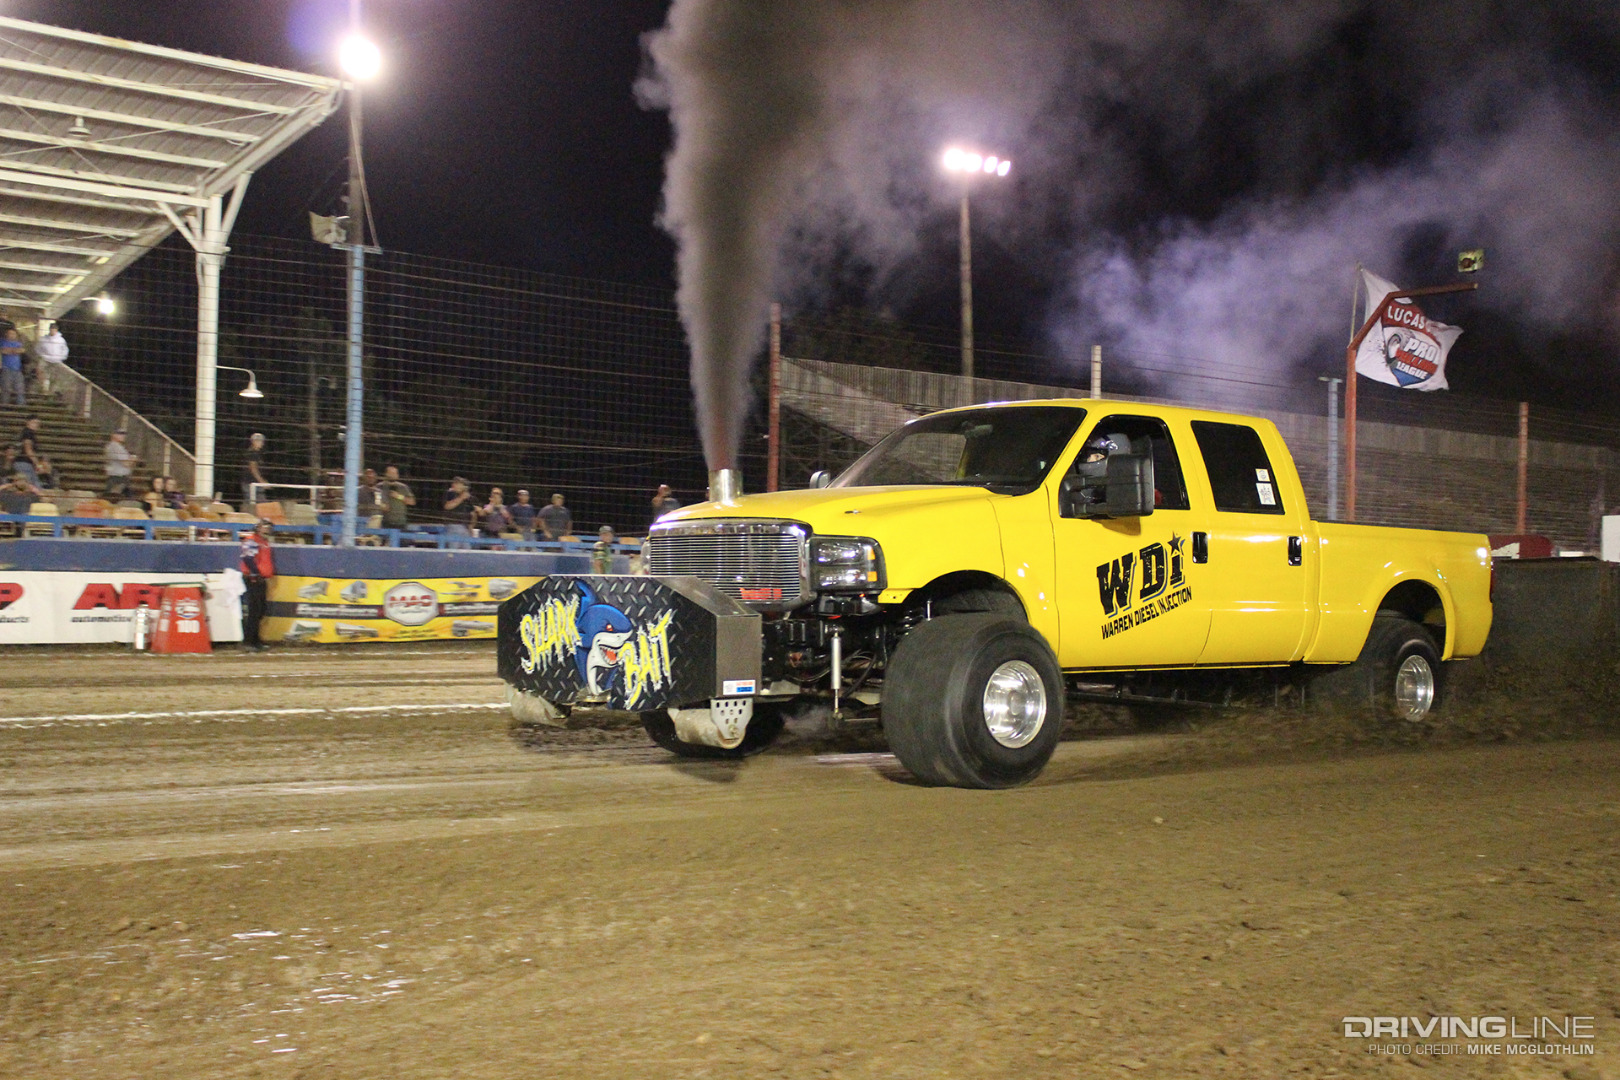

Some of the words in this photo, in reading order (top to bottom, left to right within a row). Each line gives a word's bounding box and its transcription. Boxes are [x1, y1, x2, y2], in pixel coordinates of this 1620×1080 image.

[1387, 305, 1427, 330] LUCAS
[1403, 337, 1437, 363] PRO
[1396, 361, 1429, 380] LEAGUE
[1101, 614, 1134, 640] WARREN
[1134, 602, 1160, 627] DIESEL
[1157, 585, 1193, 615] INJECTION
[520, 592, 583, 675] SHARK
[618, 608, 679, 710] BAIT
